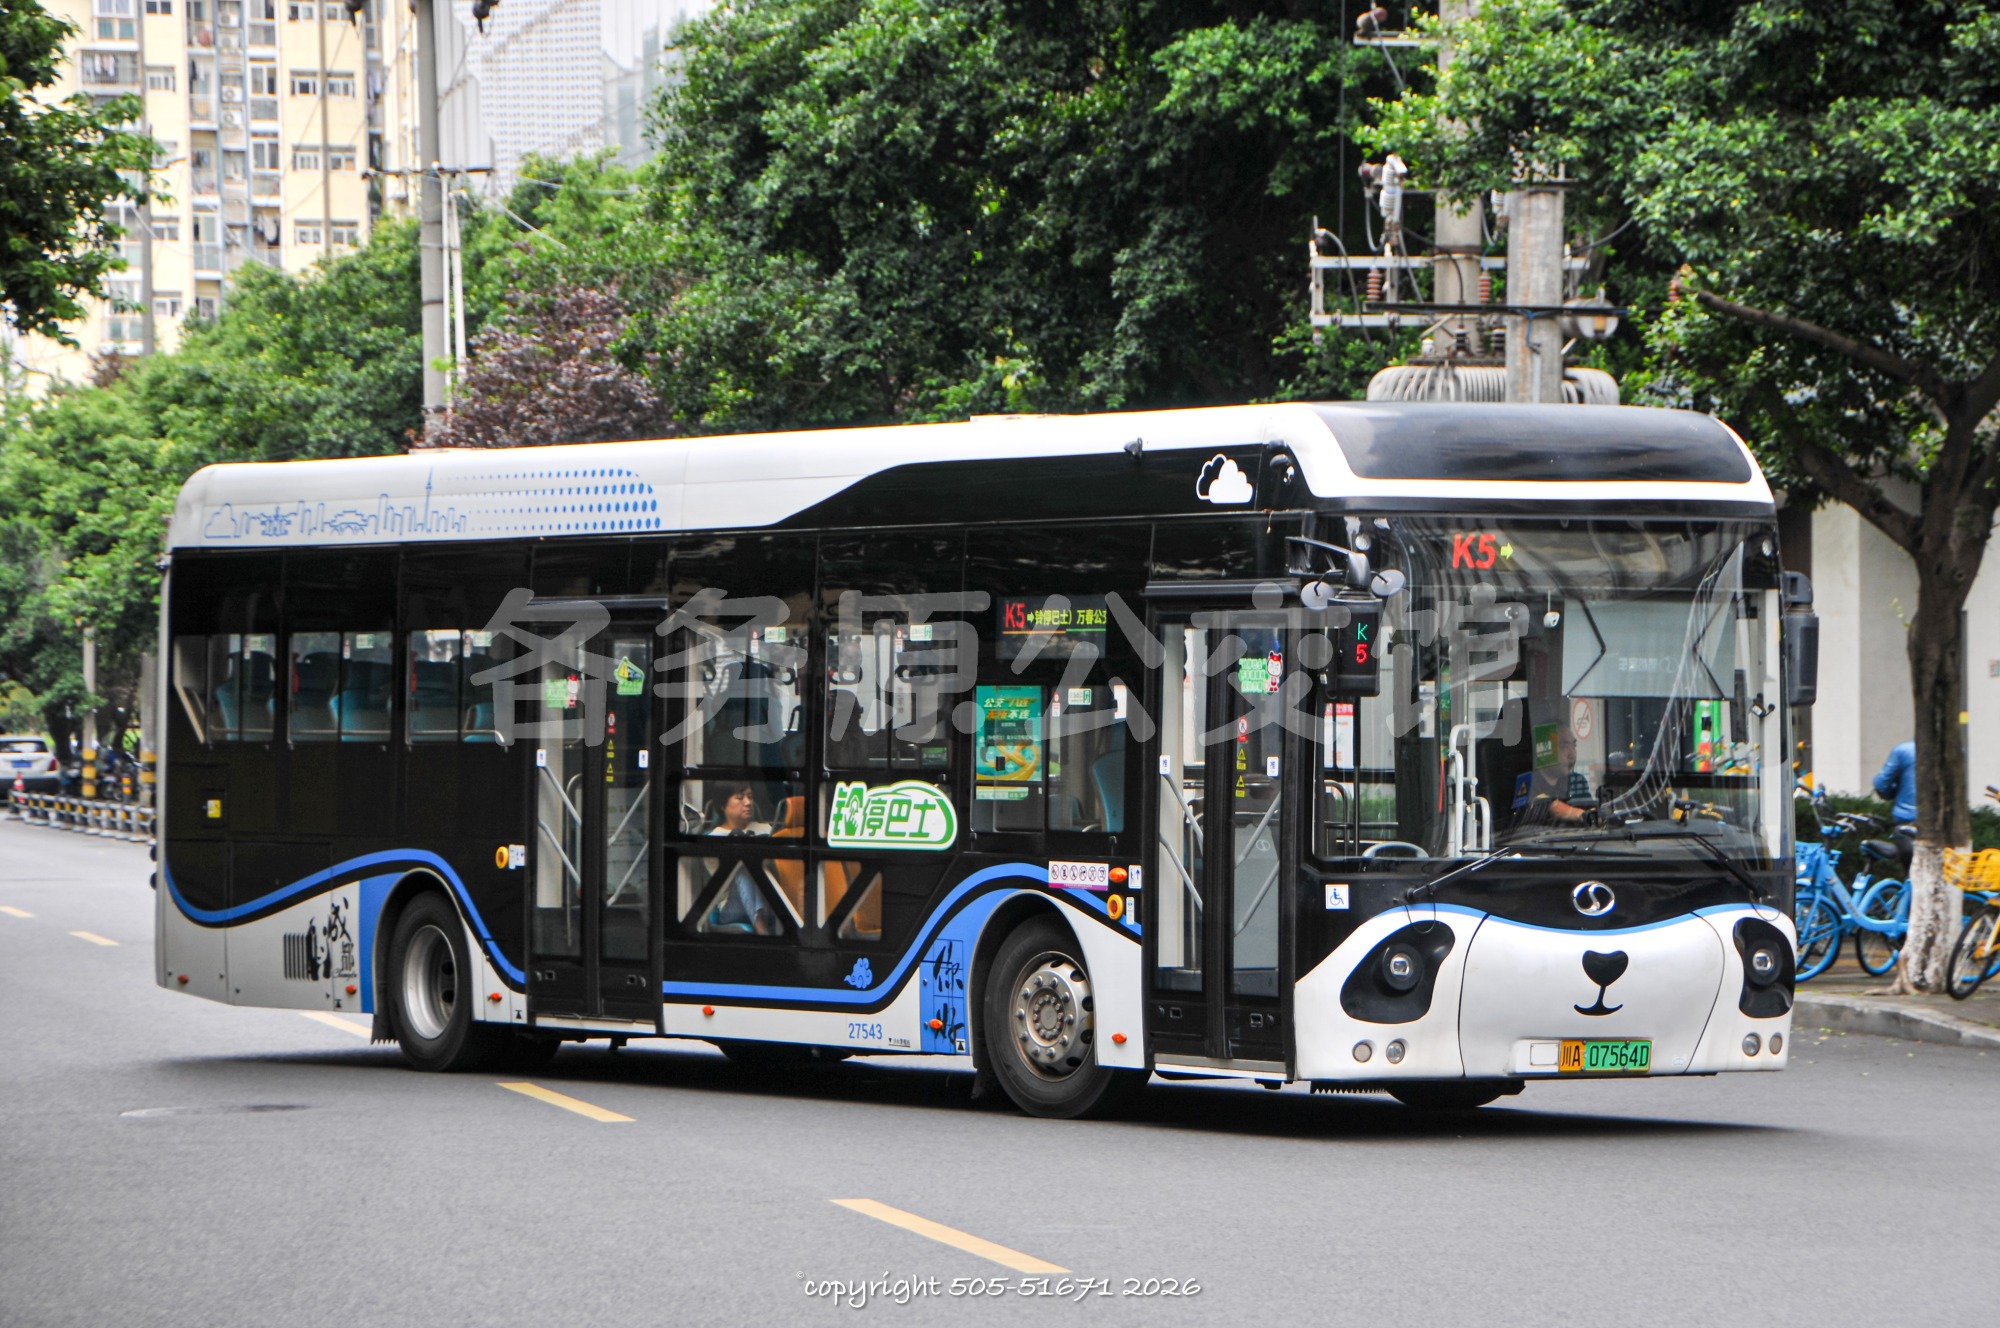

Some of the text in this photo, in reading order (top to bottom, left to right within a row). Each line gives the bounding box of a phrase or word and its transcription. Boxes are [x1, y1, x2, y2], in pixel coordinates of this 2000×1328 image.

[1451, 532, 1497, 570] K5
[1005, 602, 1026, 629] K5
[832, 786, 937, 838] 铃停巴士
[848, 1022, 883, 1040] 27543
